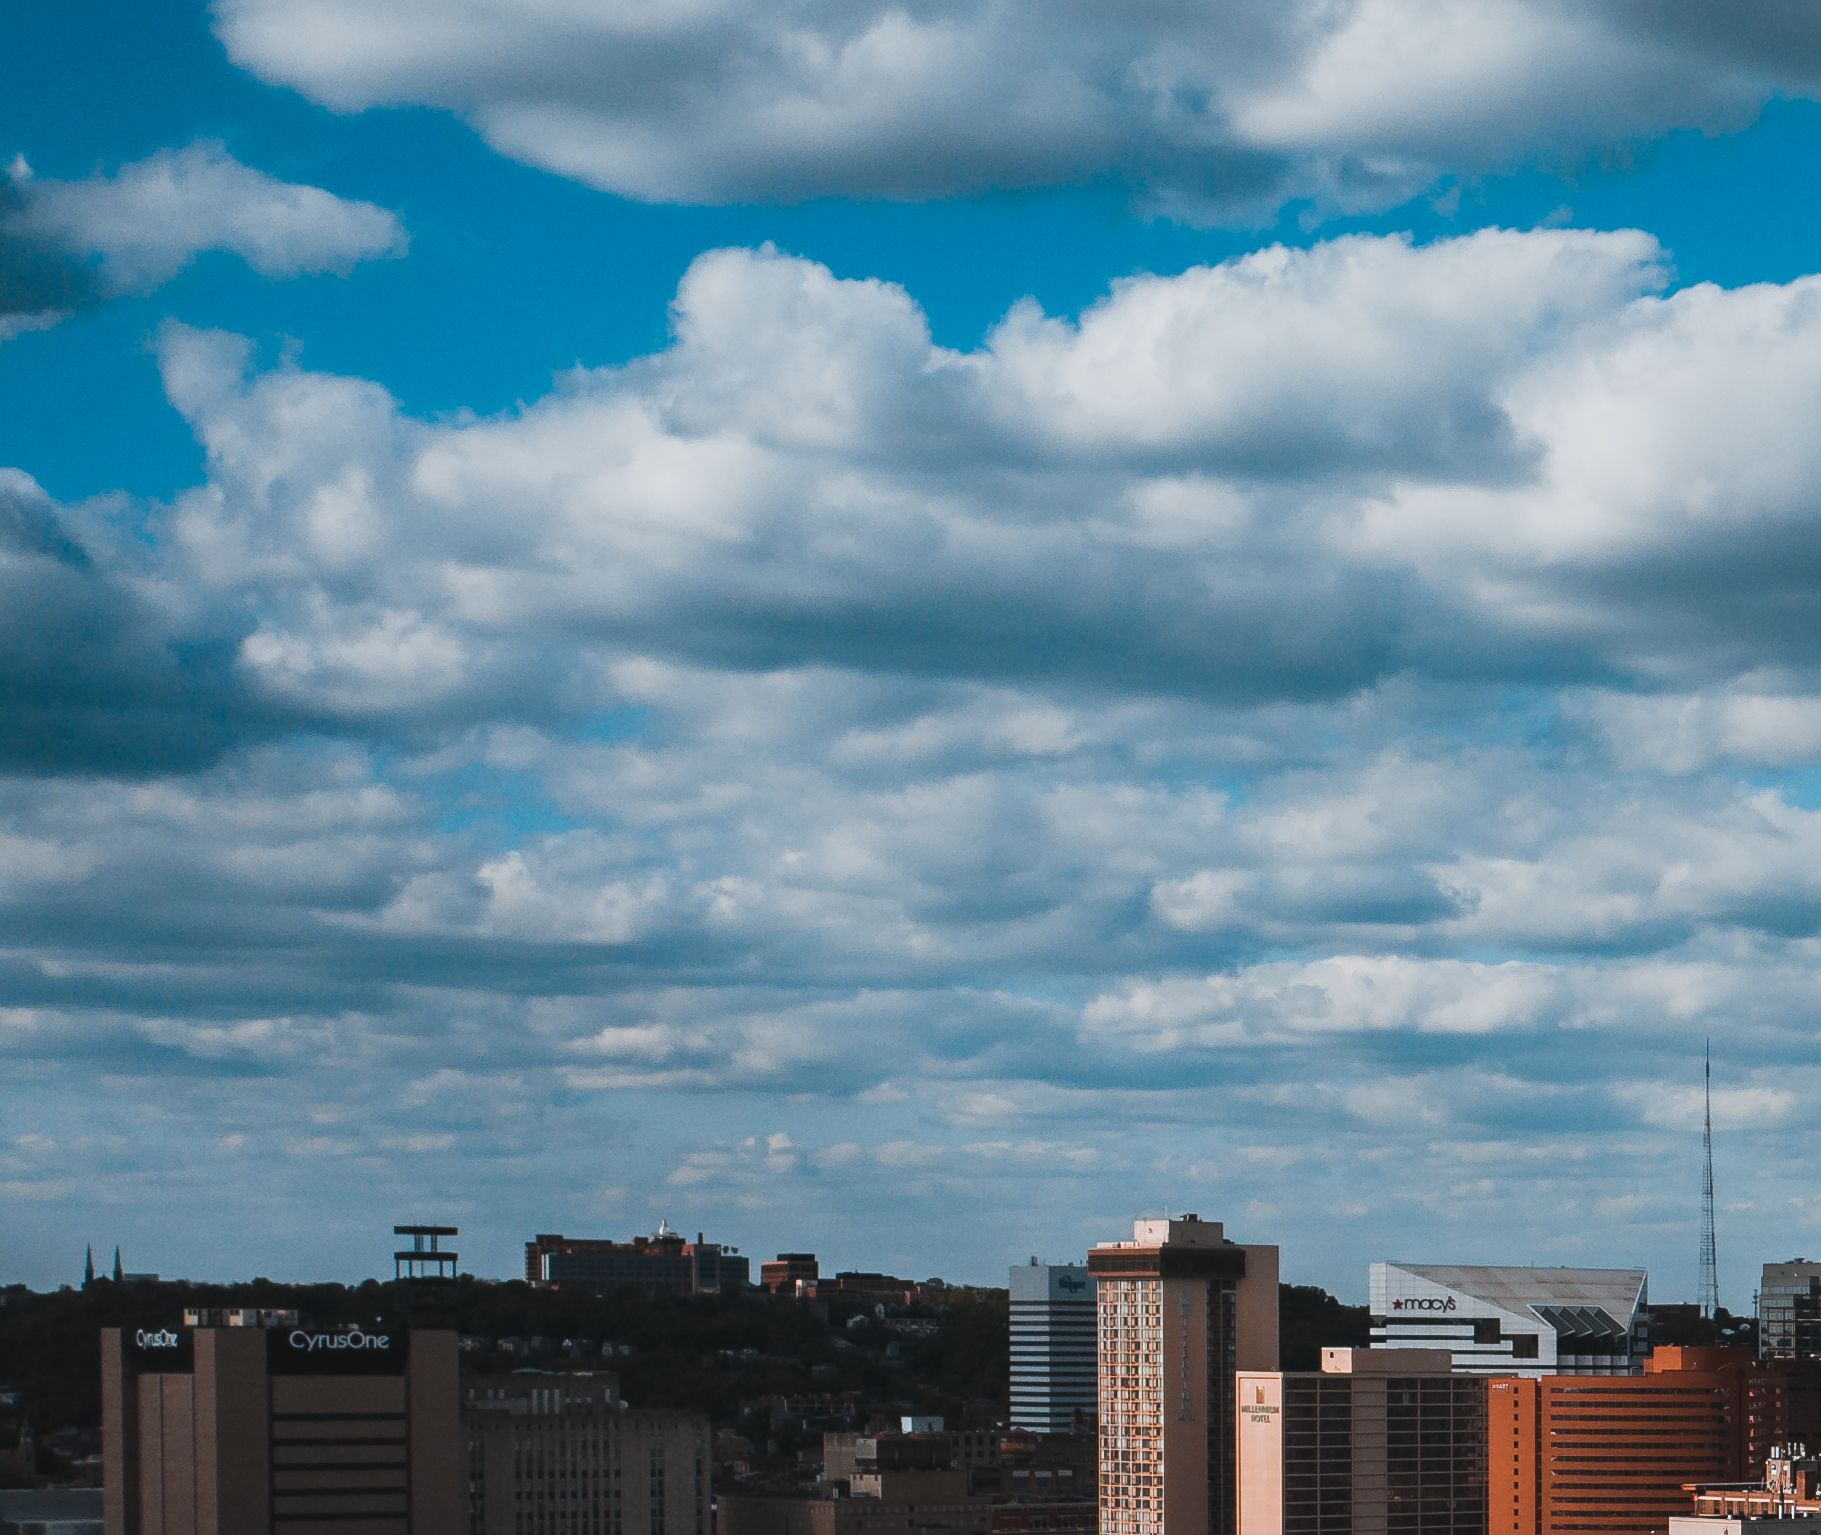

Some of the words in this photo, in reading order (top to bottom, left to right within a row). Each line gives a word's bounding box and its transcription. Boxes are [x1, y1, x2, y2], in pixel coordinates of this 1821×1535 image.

[136, 1328, 178, 1350] CyrusOne
[289, 1330, 389, 1351] CyrusOne
[1251, 1415, 1271, 1423] HOTEL
